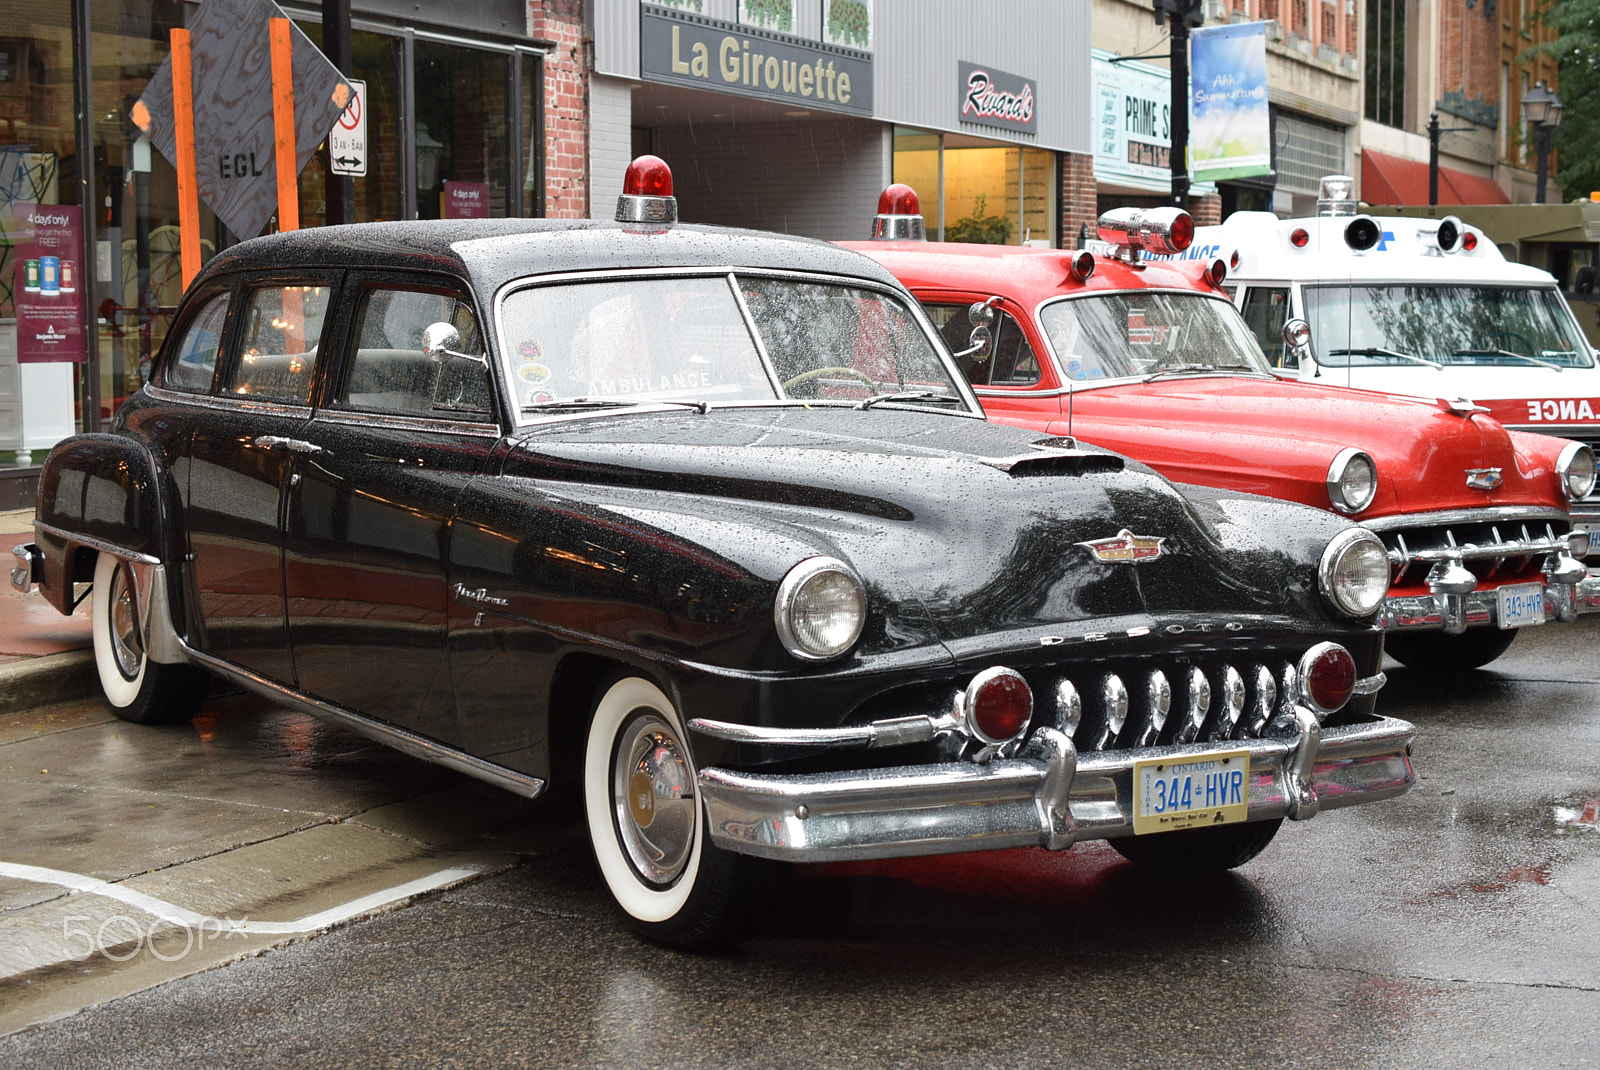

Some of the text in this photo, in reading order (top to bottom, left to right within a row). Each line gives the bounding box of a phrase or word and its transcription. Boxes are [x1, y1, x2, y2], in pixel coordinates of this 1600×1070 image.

[672, 25, 851, 104] La Girouette
[1125, 95, 1171, 140] PRIME S
[218, 152, 263, 180] EGL
[28, 213, 34, 223] 4
[35, 214, 52, 226] days
[587, 371, 712, 397] AMBULANCE
[1505, 596, 1522, 618] 343
[1526, 593, 1543, 616] HVR
[1171, 760, 1216, 776] ONTARIO
[1154, 770, 1243, 813] 344 HVR
